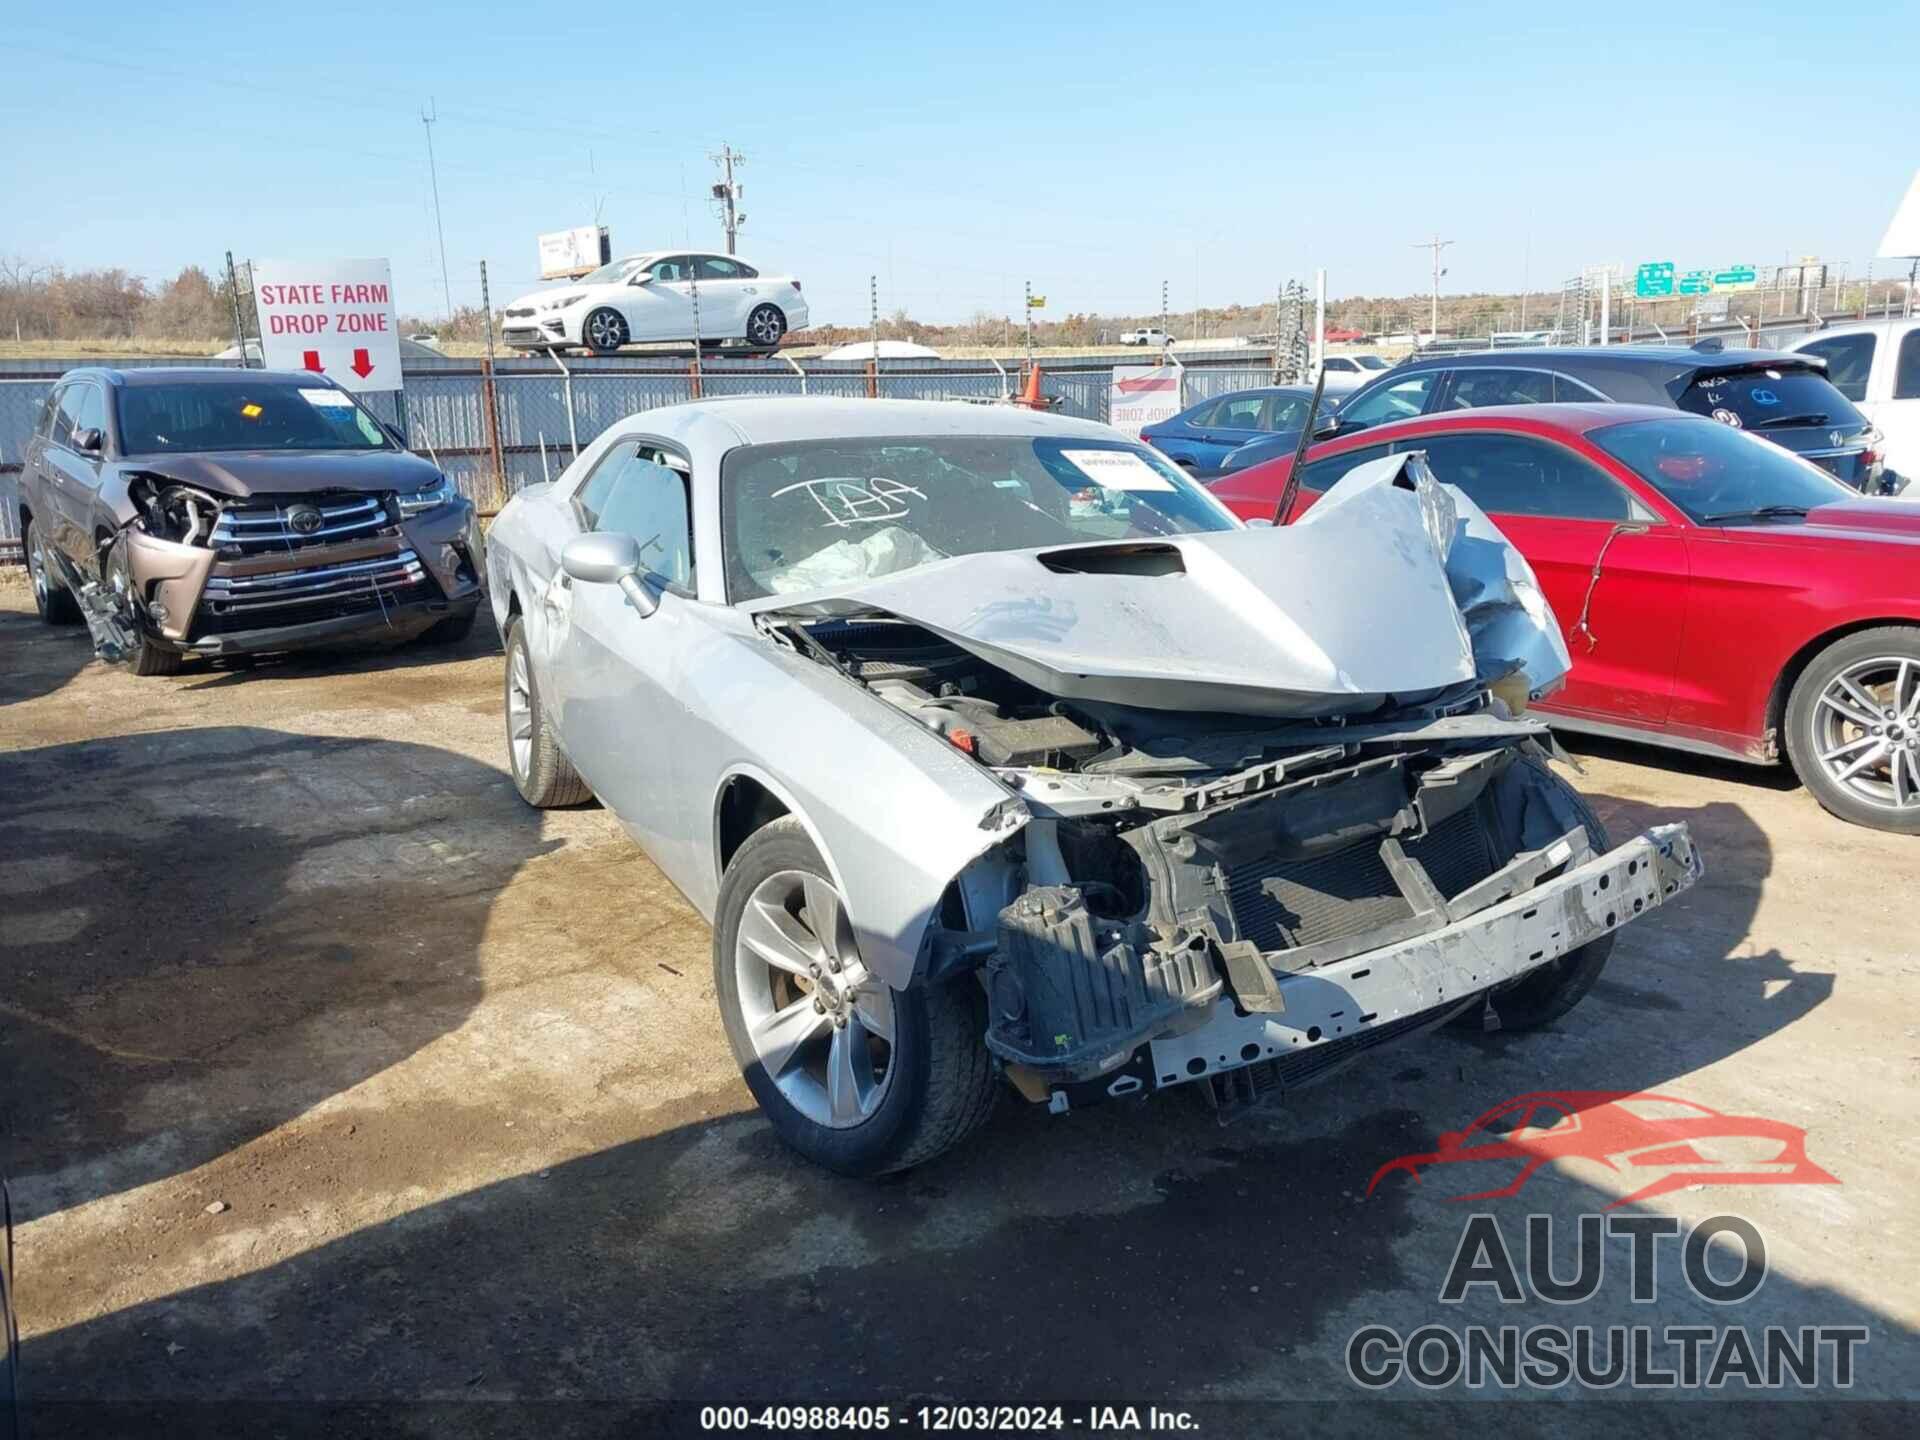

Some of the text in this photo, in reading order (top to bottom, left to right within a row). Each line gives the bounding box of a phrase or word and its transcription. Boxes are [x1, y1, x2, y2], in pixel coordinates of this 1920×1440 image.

[260, 284, 389, 305] STATE FARM
[270, 313, 389, 335] DROP ZONE
[1113, 407, 1143, 422] ZONE
